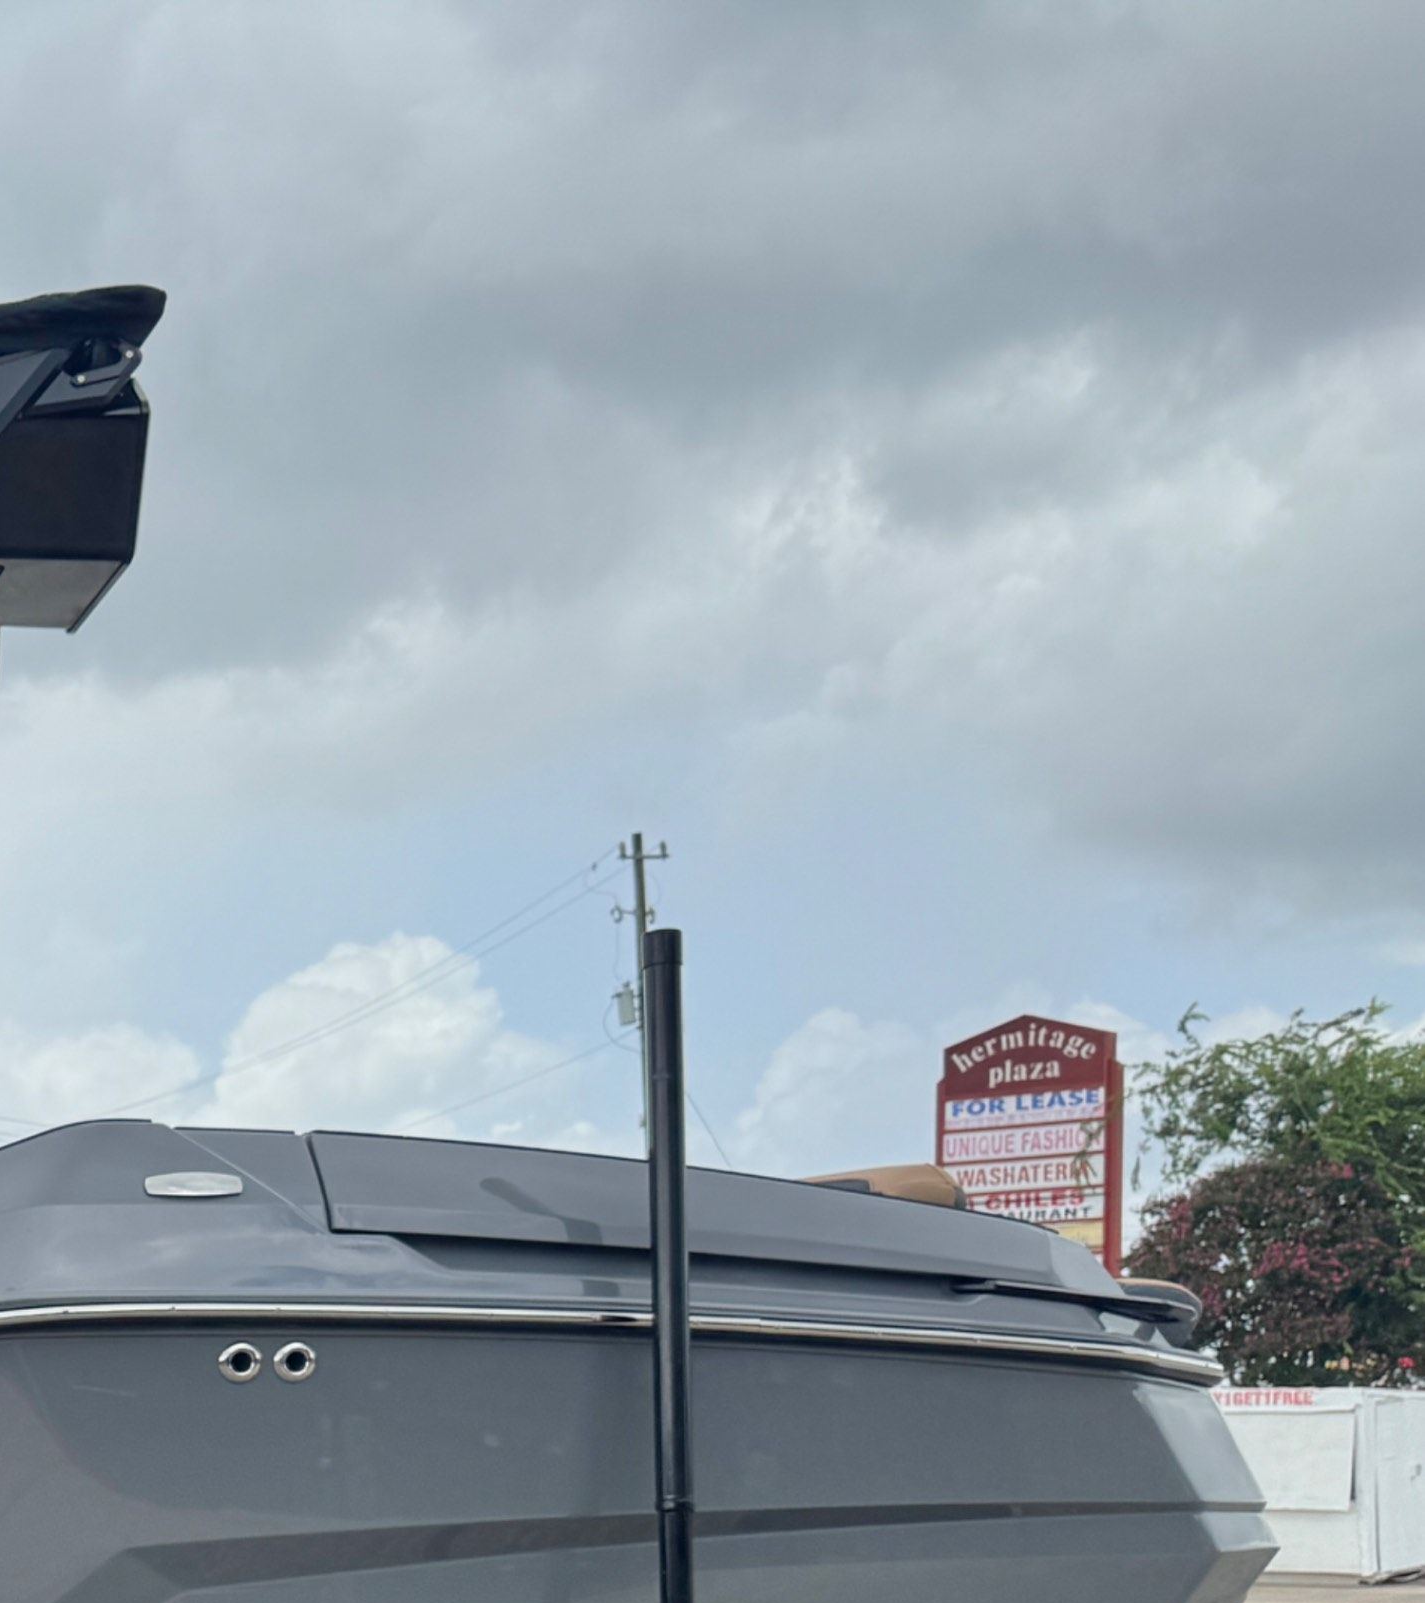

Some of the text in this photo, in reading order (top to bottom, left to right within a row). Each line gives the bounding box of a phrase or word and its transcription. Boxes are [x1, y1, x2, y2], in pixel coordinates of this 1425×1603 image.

[951, 1023, 1097, 1073] hermitage
[988, 1059, 1061, 1089] plaza
[952, 1088, 1100, 1117] FOR LEASE
[945, 1133, 1015, 1158] UNIQUE
[1005, 1206, 1092, 1220] AURANT
